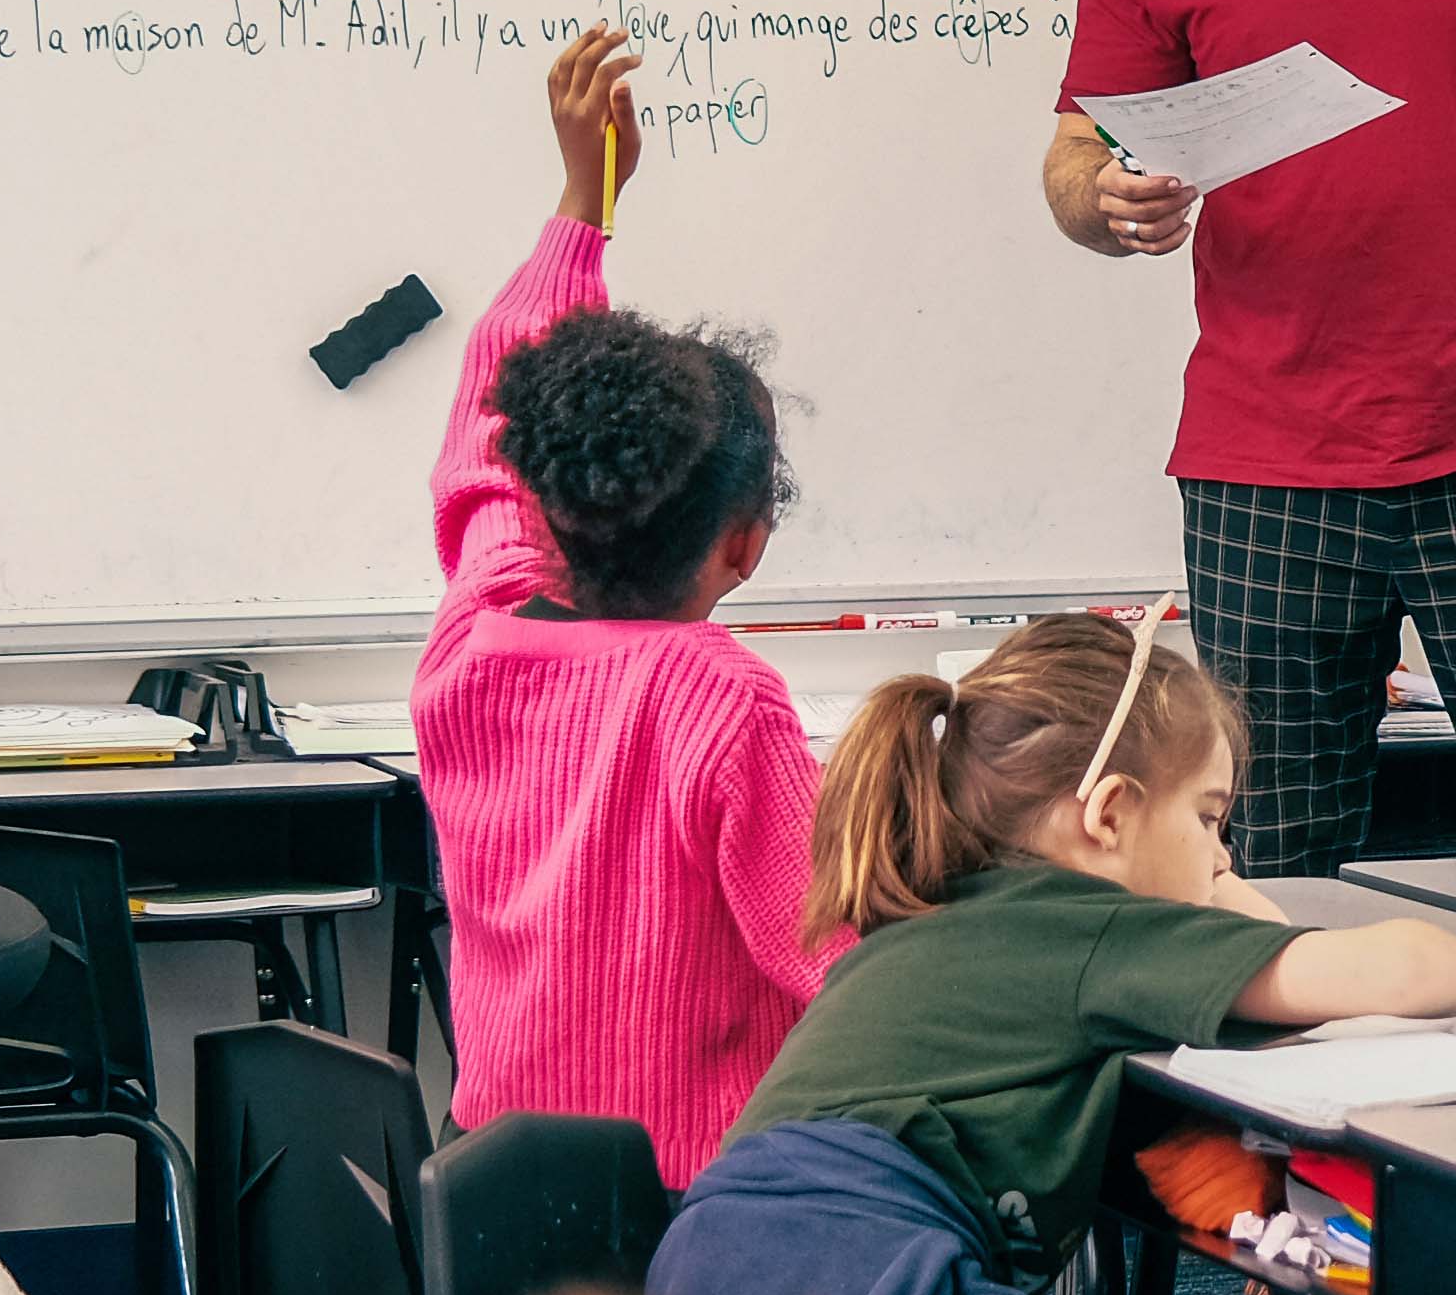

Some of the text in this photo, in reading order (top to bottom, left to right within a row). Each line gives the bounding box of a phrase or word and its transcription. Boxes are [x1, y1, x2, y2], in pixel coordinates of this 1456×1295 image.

[84, 19, 203, 52] maison
[476, 14, 488, 73] y
[500, 21, 525, 47] a
[542, 18, 581, 43] un
[697, 5, 738, 95] qui
[750, 12, 851, 77] mange
[666, 87, 766, 158] papier
